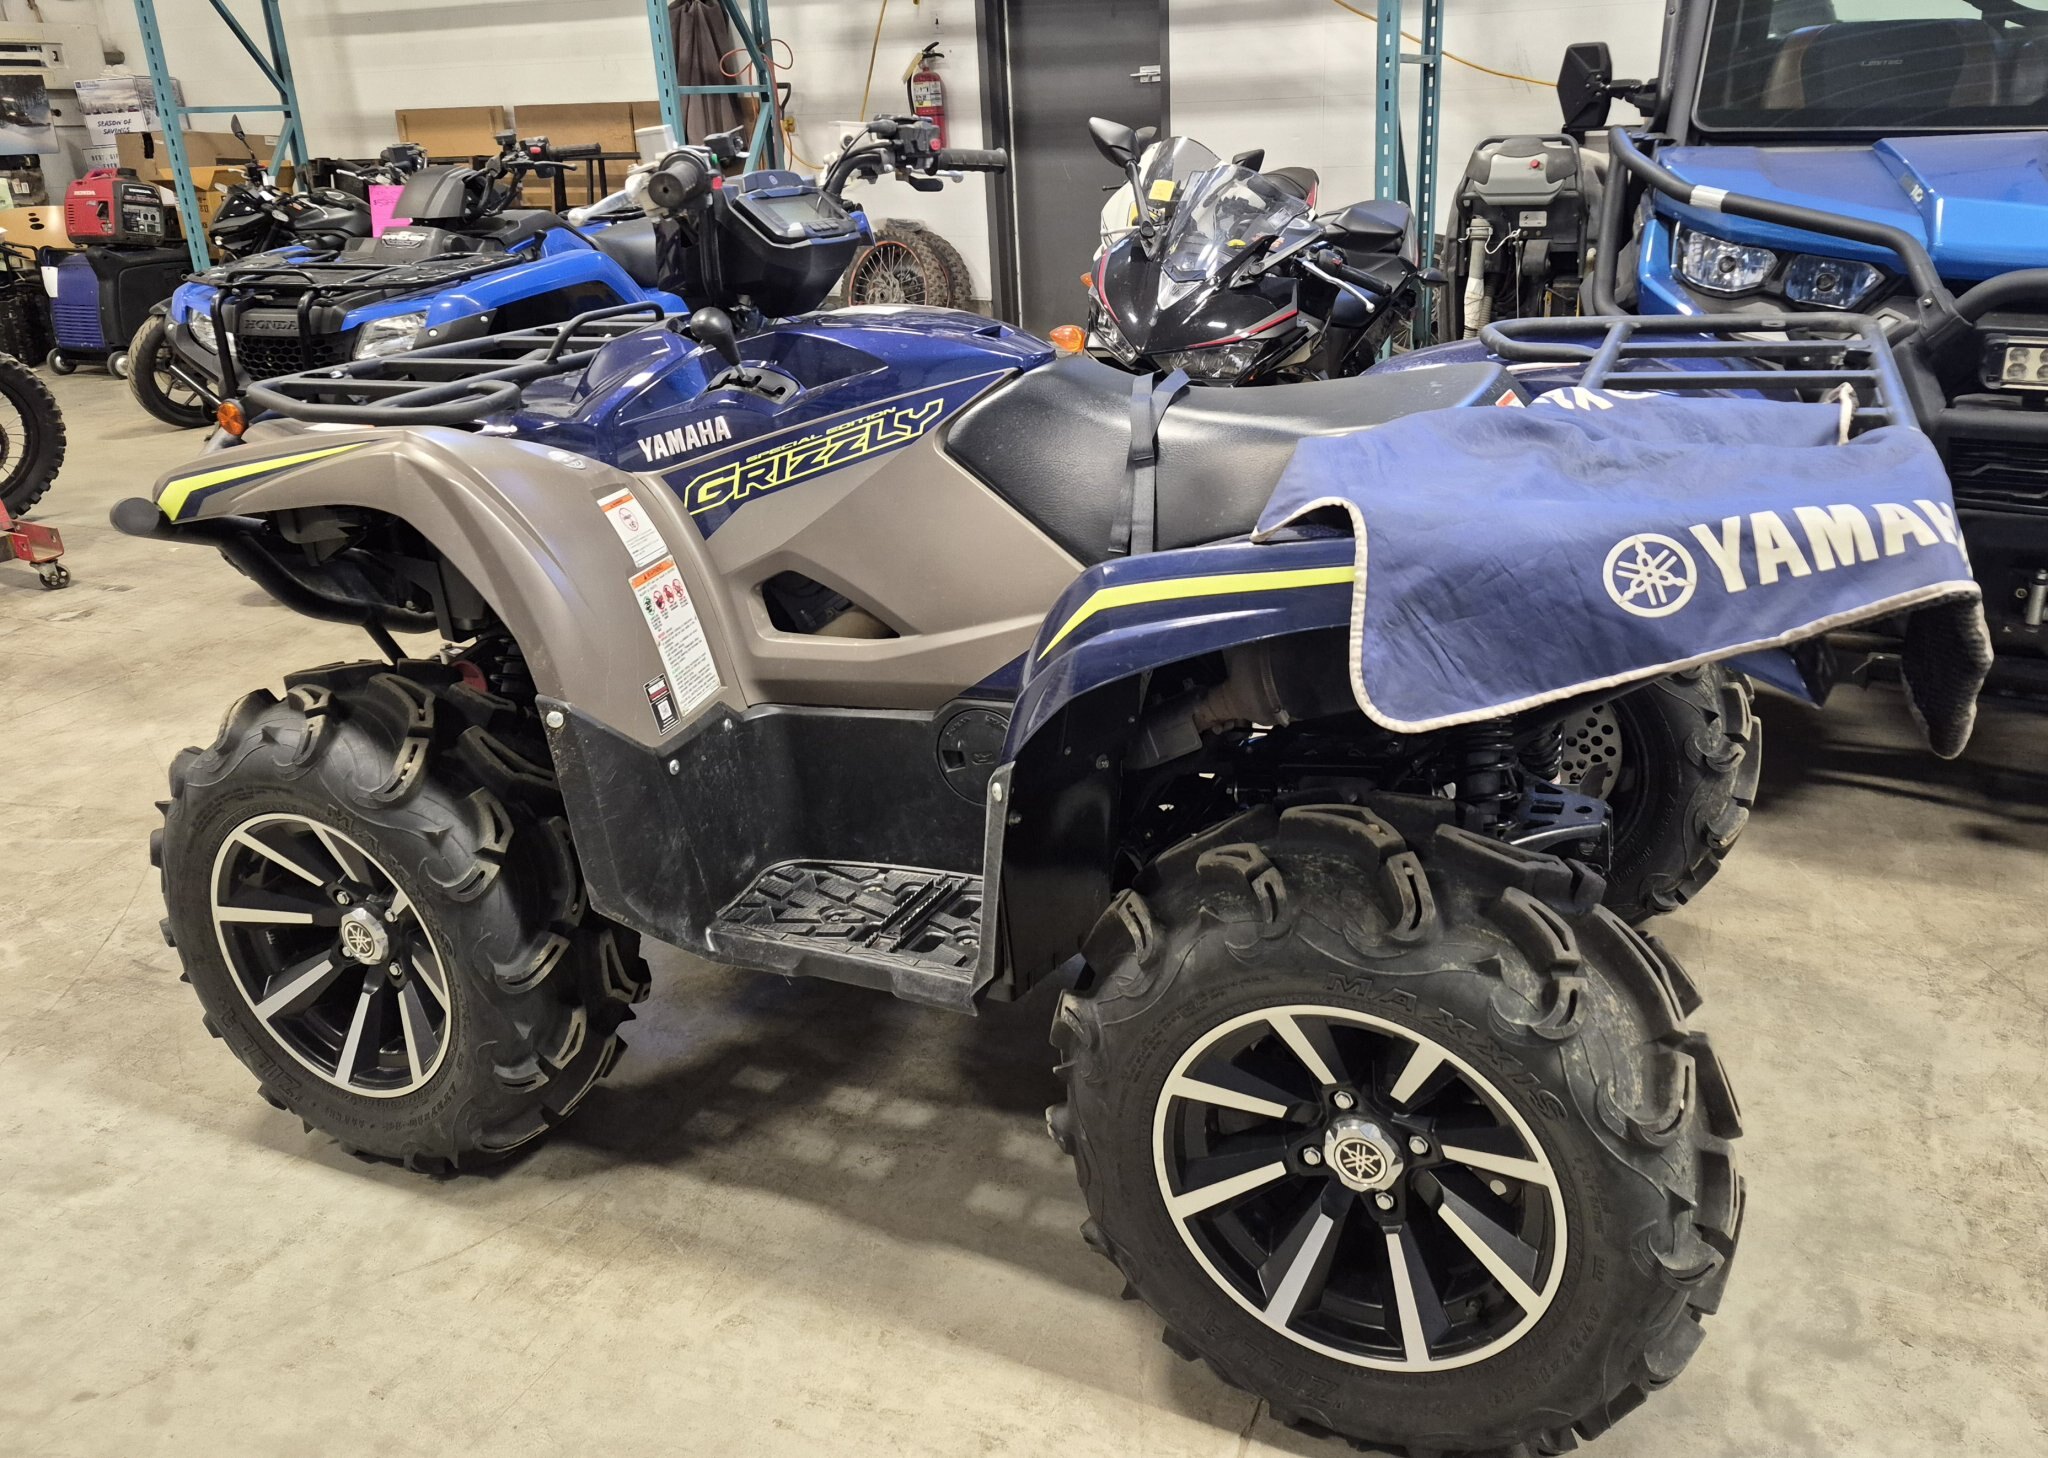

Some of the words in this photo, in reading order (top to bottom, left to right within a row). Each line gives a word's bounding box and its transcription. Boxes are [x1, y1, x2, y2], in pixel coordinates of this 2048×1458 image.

[97, 119, 122, 127] SEASON
[103, 127, 130, 135] SAVINGS
[244, 319, 298, 330] HONDA
[637, 415, 732, 462] YAMAHA
[684, 397, 945, 516] GRIZZLY
[746, 434, 823, 463] SPECIAL
[825, 406, 897, 435] EDITION
[1689, 499, 1973, 594] YAMAH
[1324, 971, 1568, 1122] MAXXIS
